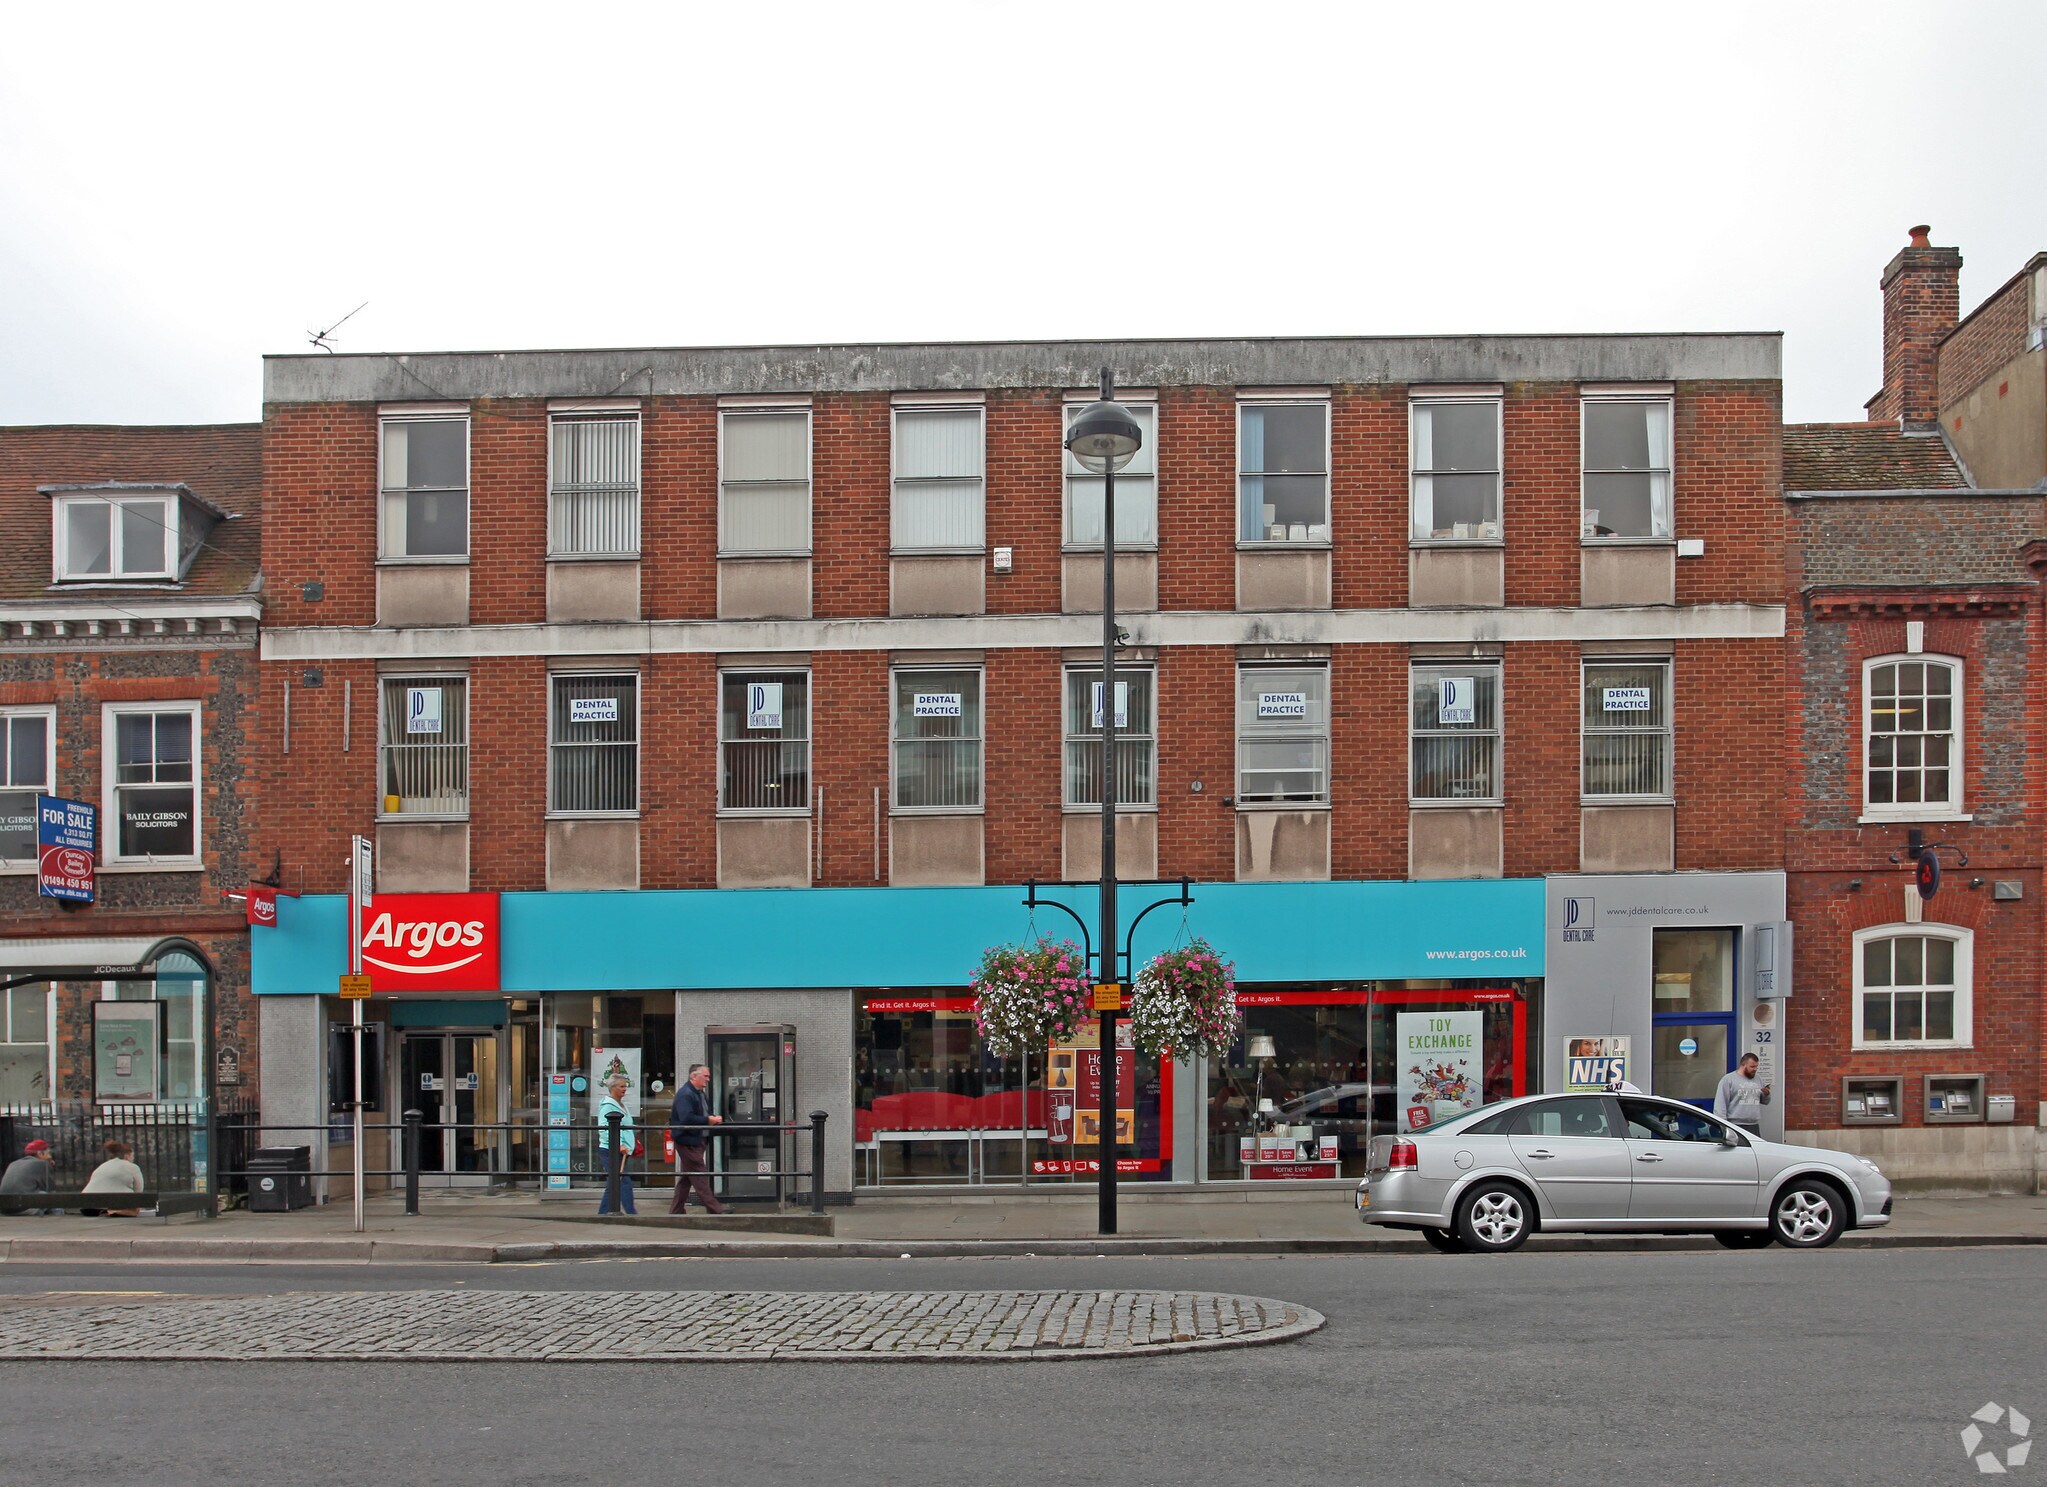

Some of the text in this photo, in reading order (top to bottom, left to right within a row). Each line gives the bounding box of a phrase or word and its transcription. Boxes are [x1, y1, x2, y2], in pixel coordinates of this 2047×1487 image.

[1264, 694, 1301, 703] DENTAL
[1443, 681, 1456, 709] JD
[1608, 690, 1645, 698] DENTAL
[411, 691, 424, 720] JD
[576, 700, 612, 709] DENTAL
[751, 686, 765, 714] JD
[919, 696, 956, 704] DENTAL
[1605, 700, 1649, 709] PRACTICE
[572, 711, 616, 720] PRACTICE
[915, 706, 960, 715] PRACTICE
[1260, 706, 1305, 714] PRACTICE
[1442, 709, 1472, 721] DENTAL CARE
[409, 719, 439, 731] DENTAL CARE
[750, 714, 780, 726] DENTAL CARE
[66, 804, 93, 816] FREEHOLD
[8, 816, 36, 824] GIBSO
[43, 808, 92, 830] FOR SALE
[55, 836, 92, 848] ALL ENQUIRIES
[65, 852, 86, 861] Duncan
[68, 858, 84, 868] Bailey
[64, 865, 86, 876] Kennedy
[44, 874, 92, 890] 01494 450 951
[53, 888, 88, 898] www.dbk.co.uk
[254, 897, 275, 914] Argos
[1565, 899, 1579, 928] JD
[1606, 906, 1710, 917] www.jddentalcare.co.uk
[362, 912, 485, 958] Argos
[1563, 930, 1594, 942] DENTAL CARE
[1426, 947, 1528, 961] www.argos.co.uk
[94, 966, 136, 974] JCDecaux
[1429, 1019, 1452, 1032] TOY
[1408, 1034, 1472, 1048] EXCHANGE
[1756, 1032, 1771, 1042] 32
[1088, 1054, 1122, 1064] Hoe
[1090, 1066, 1120, 1075] Evt
[1570, 1059, 1624, 1084] NHS
[728, 1077, 749, 1086] BT
